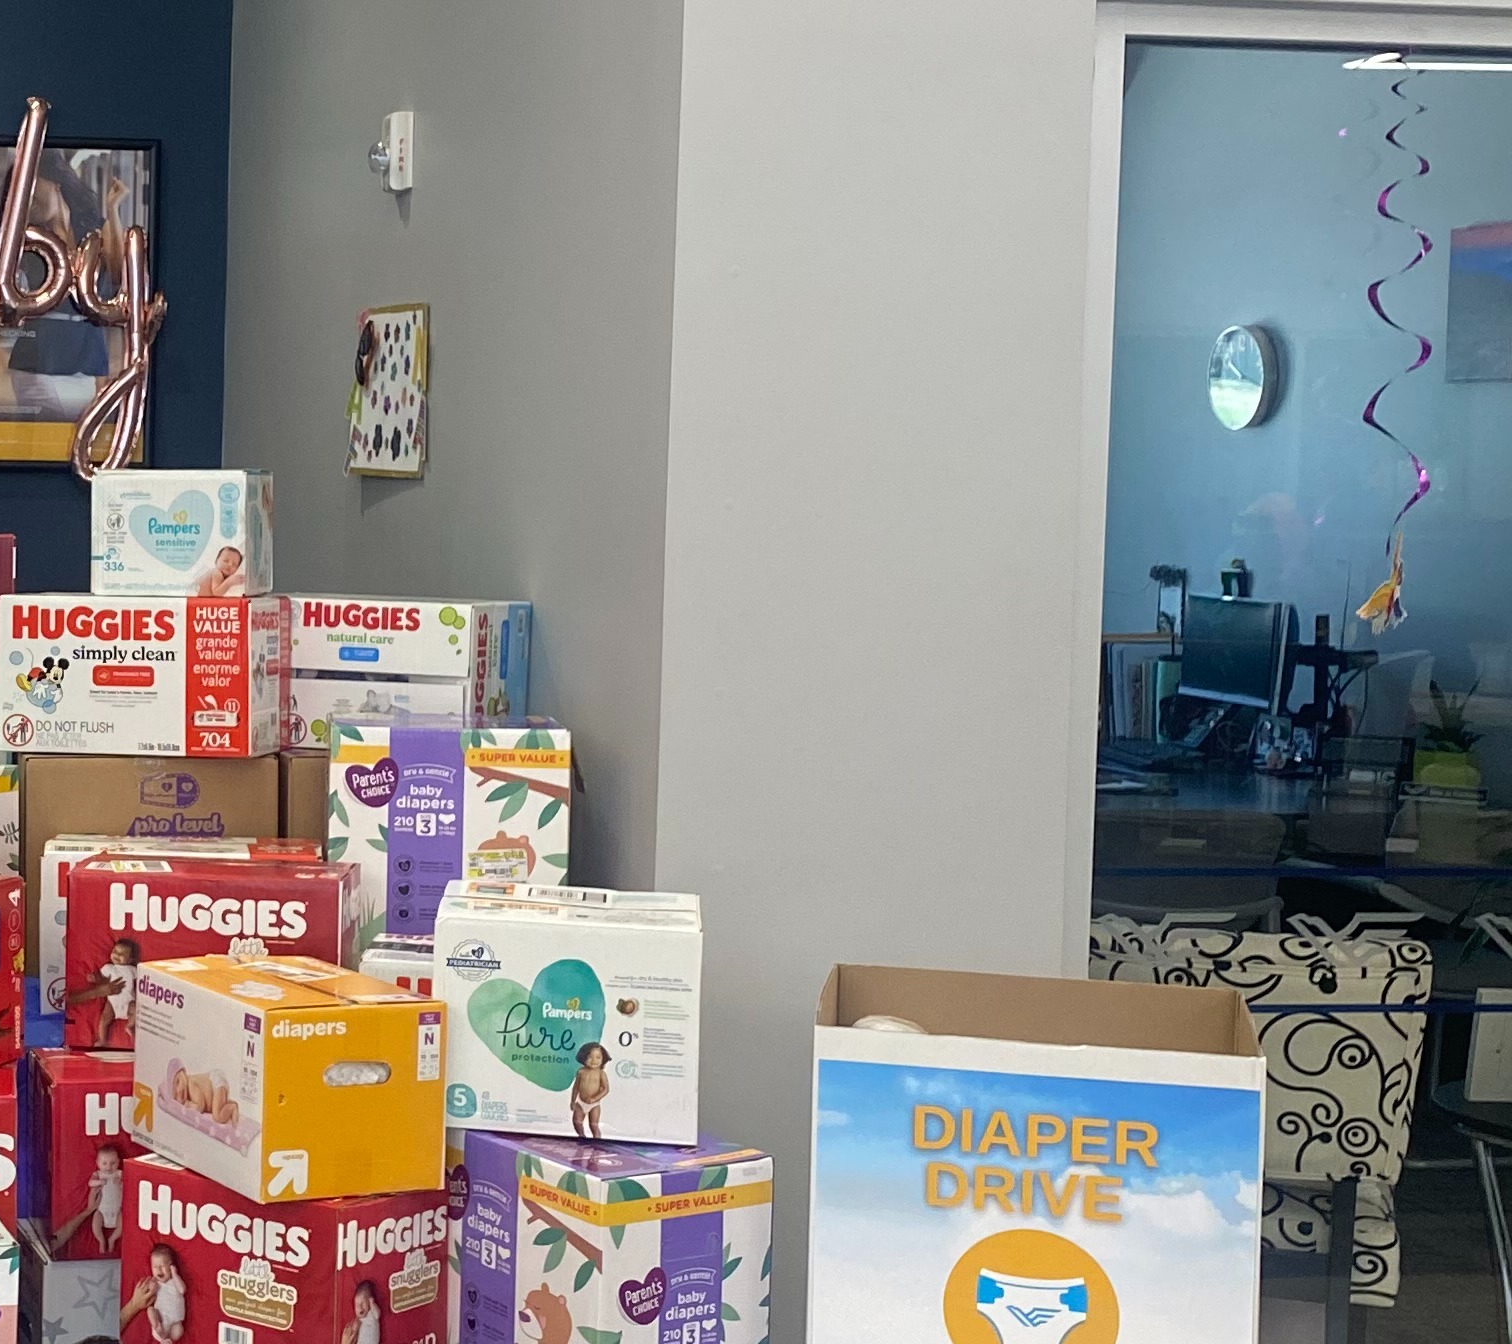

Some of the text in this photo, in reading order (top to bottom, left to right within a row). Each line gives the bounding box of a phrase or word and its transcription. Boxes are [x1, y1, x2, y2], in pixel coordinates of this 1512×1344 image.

[148, 517, 201, 538] Pampers
[155, 539, 197, 547] sensitive
[103, 561, 125, 572] 336
[196, 607, 239, 620] HUGE
[302, 601, 421, 632] HUGGIES
[11, 605, 176, 642] HUGGIES
[193, 620, 241, 634] VALUE
[195, 636, 238, 650] grande
[72, 645, 176, 664] simply clean
[198, 649, 234, 661] valeur
[193, 665, 240, 675] enorme
[201, 676, 231, 687] valor
[35, 720, 115, 734] DO NOT FLUSH
[199, 733, 231, 748] 704
[479, 752, 558, 765] SUPER VALUE
[410, 784, 443, 799] baby
[396, 797, 455, 812] diapers
[394, 816, 431, 834] 210 3
[7, 888, 21, 907] 4
[109, 882, 307, 940] HUGGIES
[138, 975, 185, 1010] diapers
[542, 1003, 592, 1021] Pampers
[271, 1019, 347, 1041] diapers
[496, 1002, 576, 1051] Pure
[423, 1032, 435, 1046] N
[246, 1040, 256, 1058] N
[511, 1052, 570, 1065] protection
[453, 1087, 467, 1106] 5
[913, 1103, 1159, 1168] DIAPER
[924, 1162, 1124, 1223] DRIVE
[655, 1192, 728, 1213] SUPER VALUE
[138, 1179, 310, 1267] HUGGIES
[337, 1204, 448, 1271] HUGGIES
[219, 1271, 297, 1303] snugglers
[677, 1290, 707, 1307] baby
[665, 1301, 716, 1322] diapers
[663, 1327, 697, 1344] 210 3
